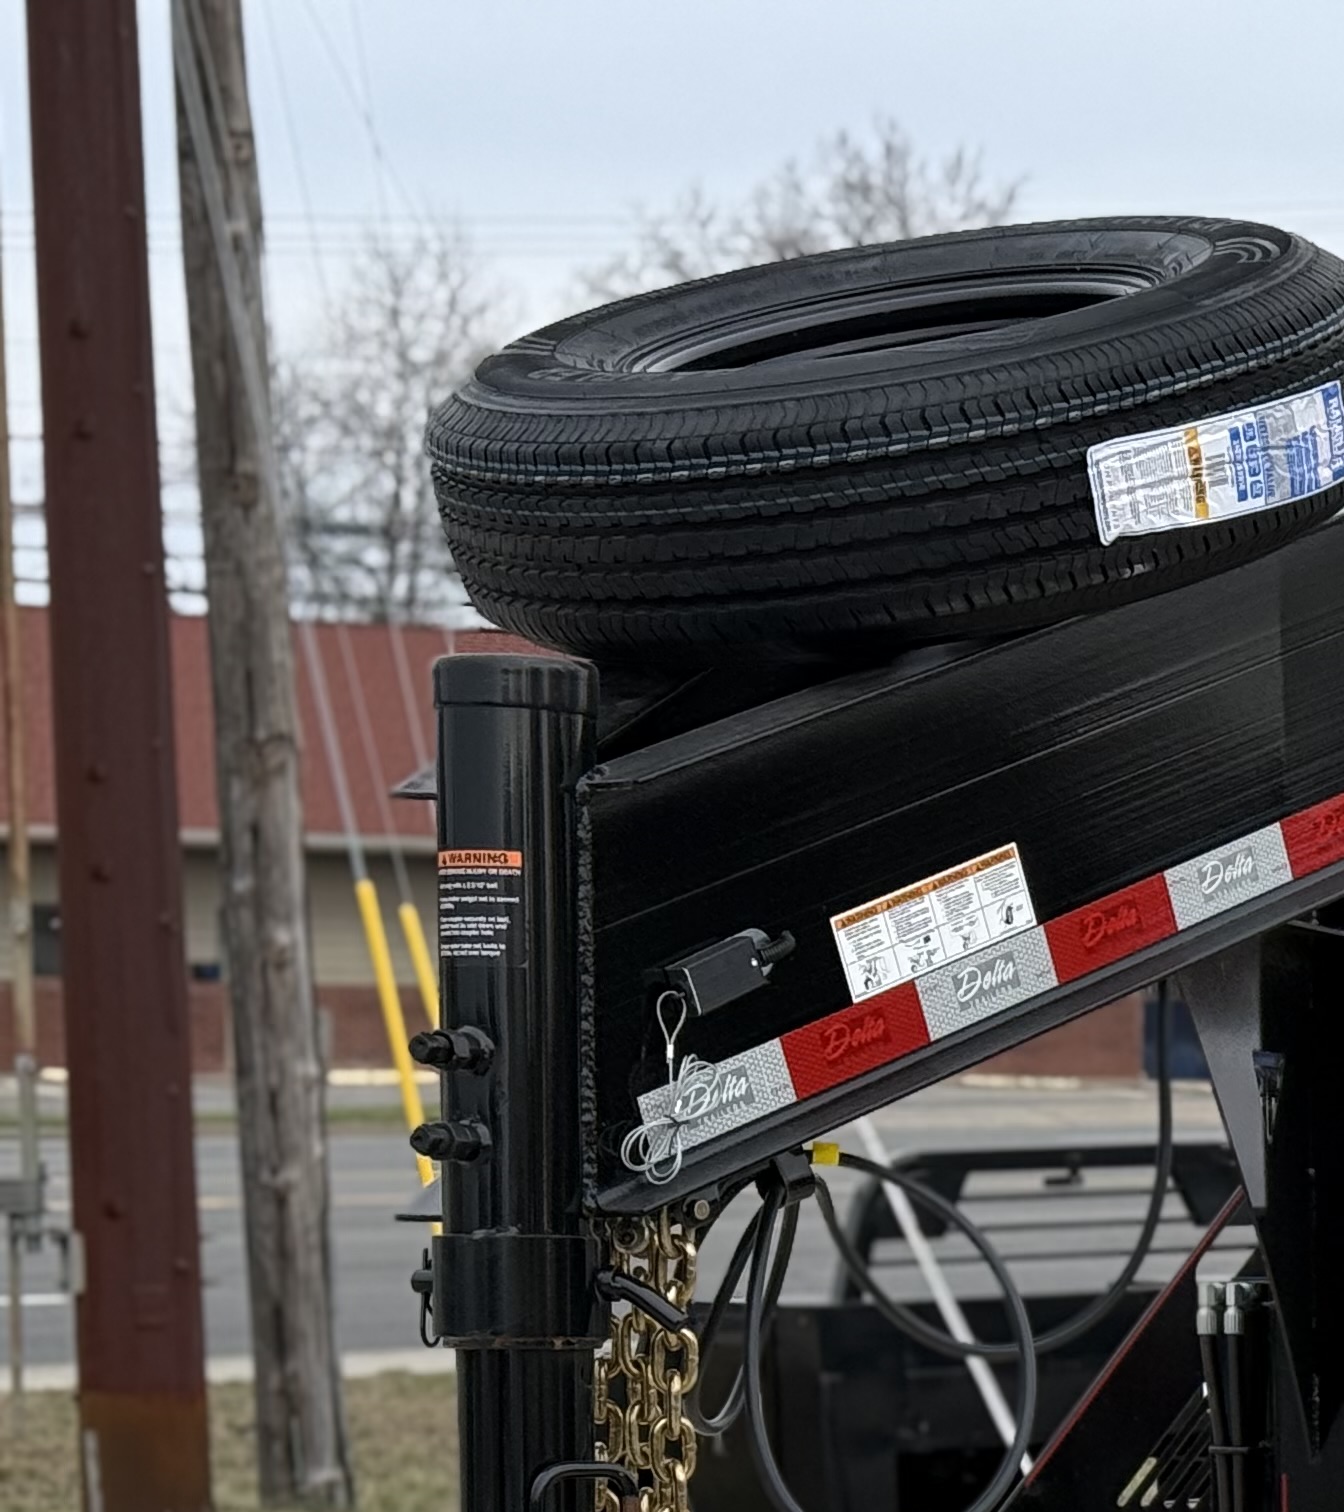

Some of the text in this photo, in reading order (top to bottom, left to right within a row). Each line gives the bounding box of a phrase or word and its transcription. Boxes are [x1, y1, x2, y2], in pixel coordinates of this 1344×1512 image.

[448, 852, 508, 864] WARNING
[1201, 852, 1255, 894] Delta
[956, 959, 1015, 1003] Delta
